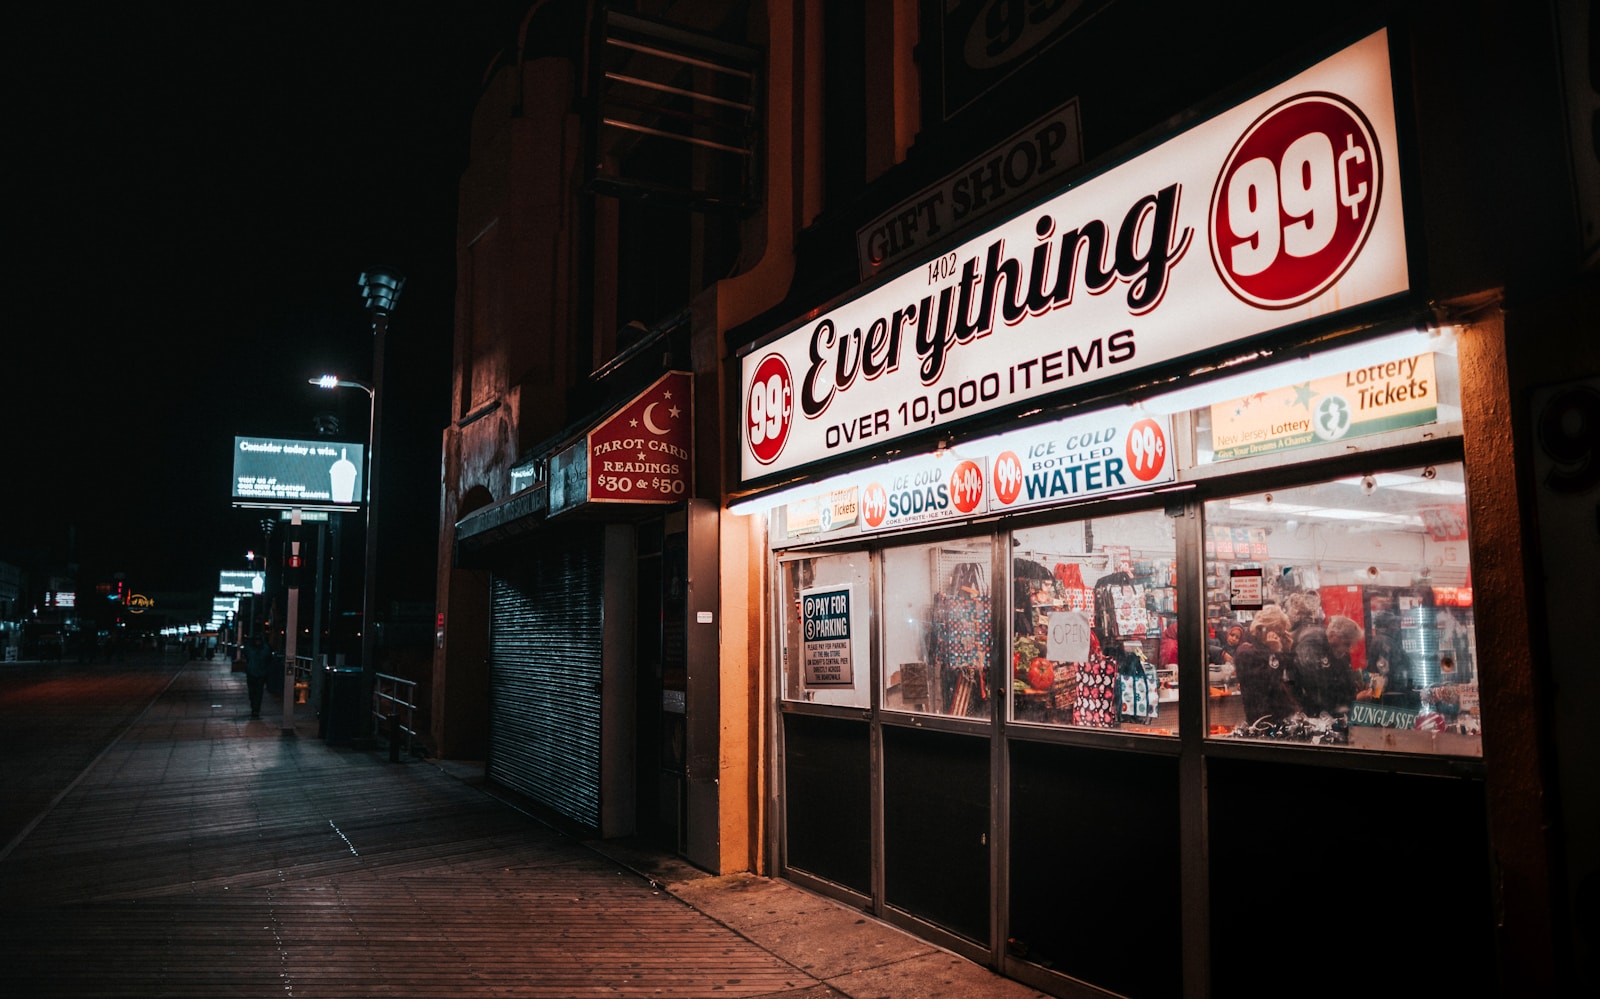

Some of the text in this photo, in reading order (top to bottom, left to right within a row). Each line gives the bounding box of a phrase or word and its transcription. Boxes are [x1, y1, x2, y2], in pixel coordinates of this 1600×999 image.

[867, 121, 1067, 266] GIFT SHOP
[1228, 132, 1370, 276] 99¢
[927, 252, 957, 286] 1402
[801, 182, 1194, 420] Everything
[825, 330, 1136, 449] OVER 10,000 ITEMS
[1358, 378, 1428, 410] Tickets
[747, 376, 793, 446] 99¢
[1028, 427, 1116, 459] ICE COLD
[1217, 419, 1311, 447] New Jersey Lottery
[240, 441, 282, 453] Consider
[283, 444, 308, 456] today
[594, 439, 688, 460] TAROT CARD
[1032, 446, 1113, 471] BOTTLED
[1131, 425, 1164, 472] 99¢
[1218, 450, 1233, 458] Give
[1233, 447, 1249, 457] Your
[1250, 442, 1276, 453] Dreams
[1278, 439, 1285, 448] A
[603, 461, 680, 474] READINGS
[893, 467, 942, 491] ICE COLD
[997, 457, 1023, 496] 99¢
[1025, 457, 1126, 501] WATER
[598, 474, 685, 494] $30 & $50
[834, 503, 856, 517] Tickets
[888, 483, 949, 518] SODAS
[815, 597, 829, 616] PAY
[831, 595, 847, 614] FOR
[815, 617, 847, 637] PARKING
[1052, 622, 1089, 646] OPEN
